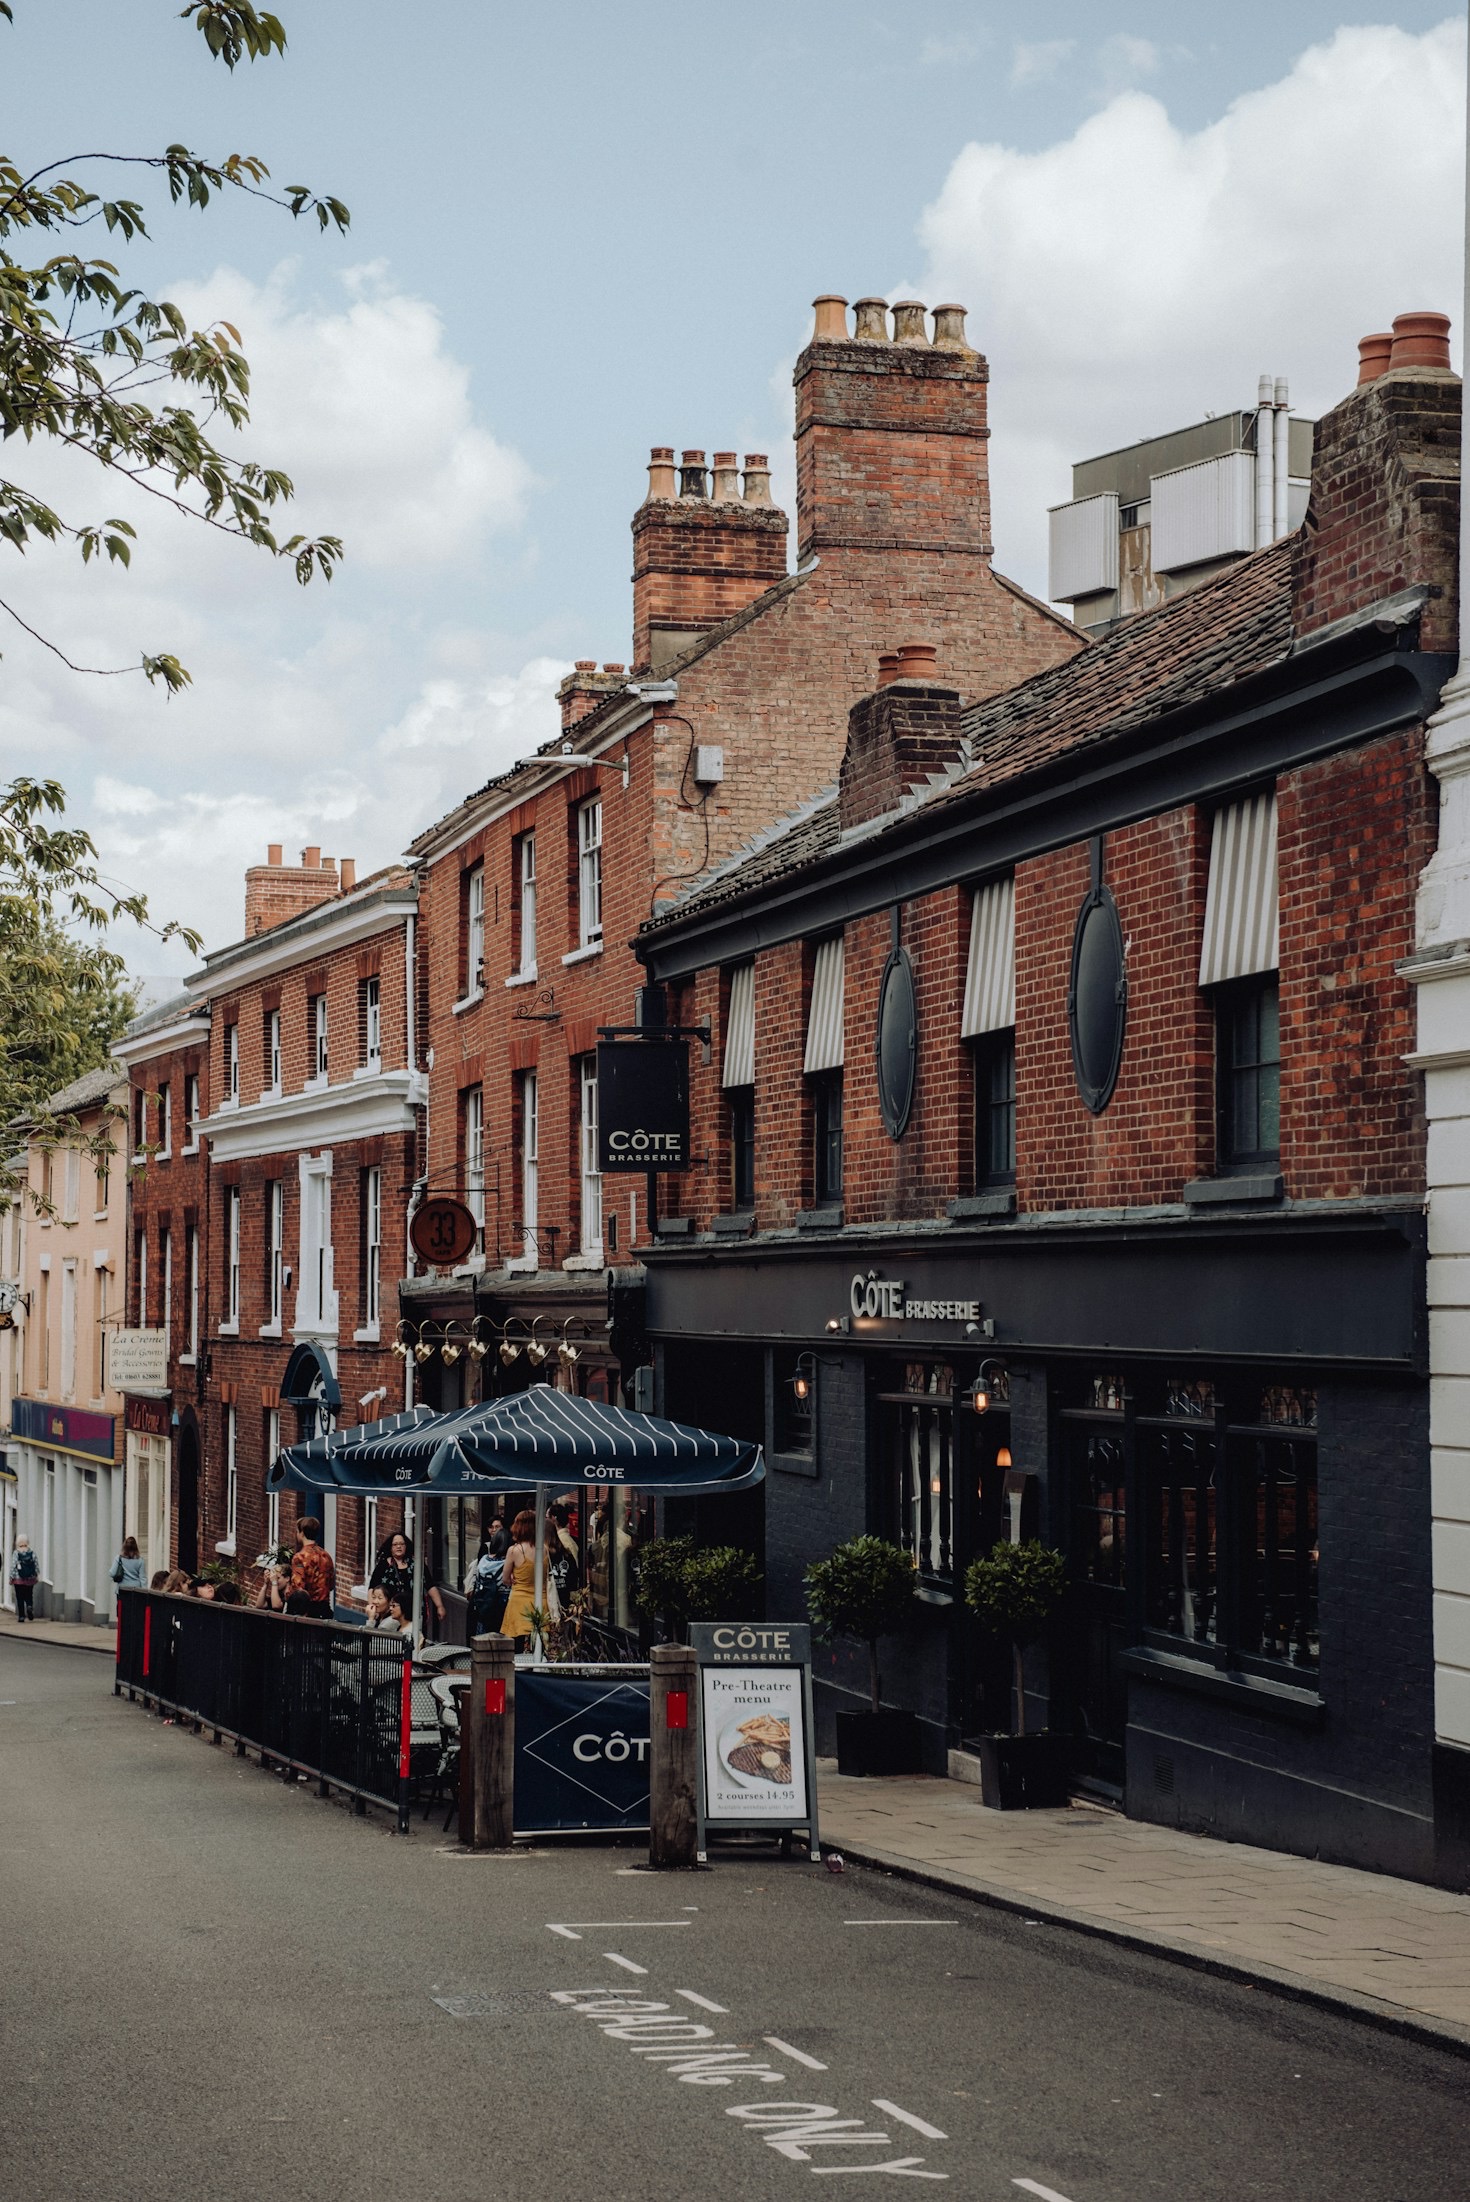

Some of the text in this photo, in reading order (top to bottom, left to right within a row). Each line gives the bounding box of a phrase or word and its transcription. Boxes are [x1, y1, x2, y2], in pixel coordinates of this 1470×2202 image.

[608, 1128, 681, 1150] CÔTE
[608, 1154, 682, 1162] BRASSERIE
[429, 1211, 456, 1248] 33
[850, 1269, 980, 1320] CÔTE BRASSERIE
[111, 1335, 127, 1344] La
[111, 1347, 163, 1359] Bridal Gowns
[111, 1359, 163, 1368] & Accessories
[395, 1468, 413, 1480] CÔTE
[583, 1465, 625, 1479] CÔTE
[713, 1626, 791, 1649] CÔTE
[713, 1653, 791, 1661] BRASSERIE
[712, 1680, 792, 1691] Pre-Theatre
[734, 1696, 771, 1704] menu
[572, 1730, 652, 1762] CÔT
[767, 1790, 795, 1800] 14.95
[549, 1989, 950, 2180] LOADING ONLY
